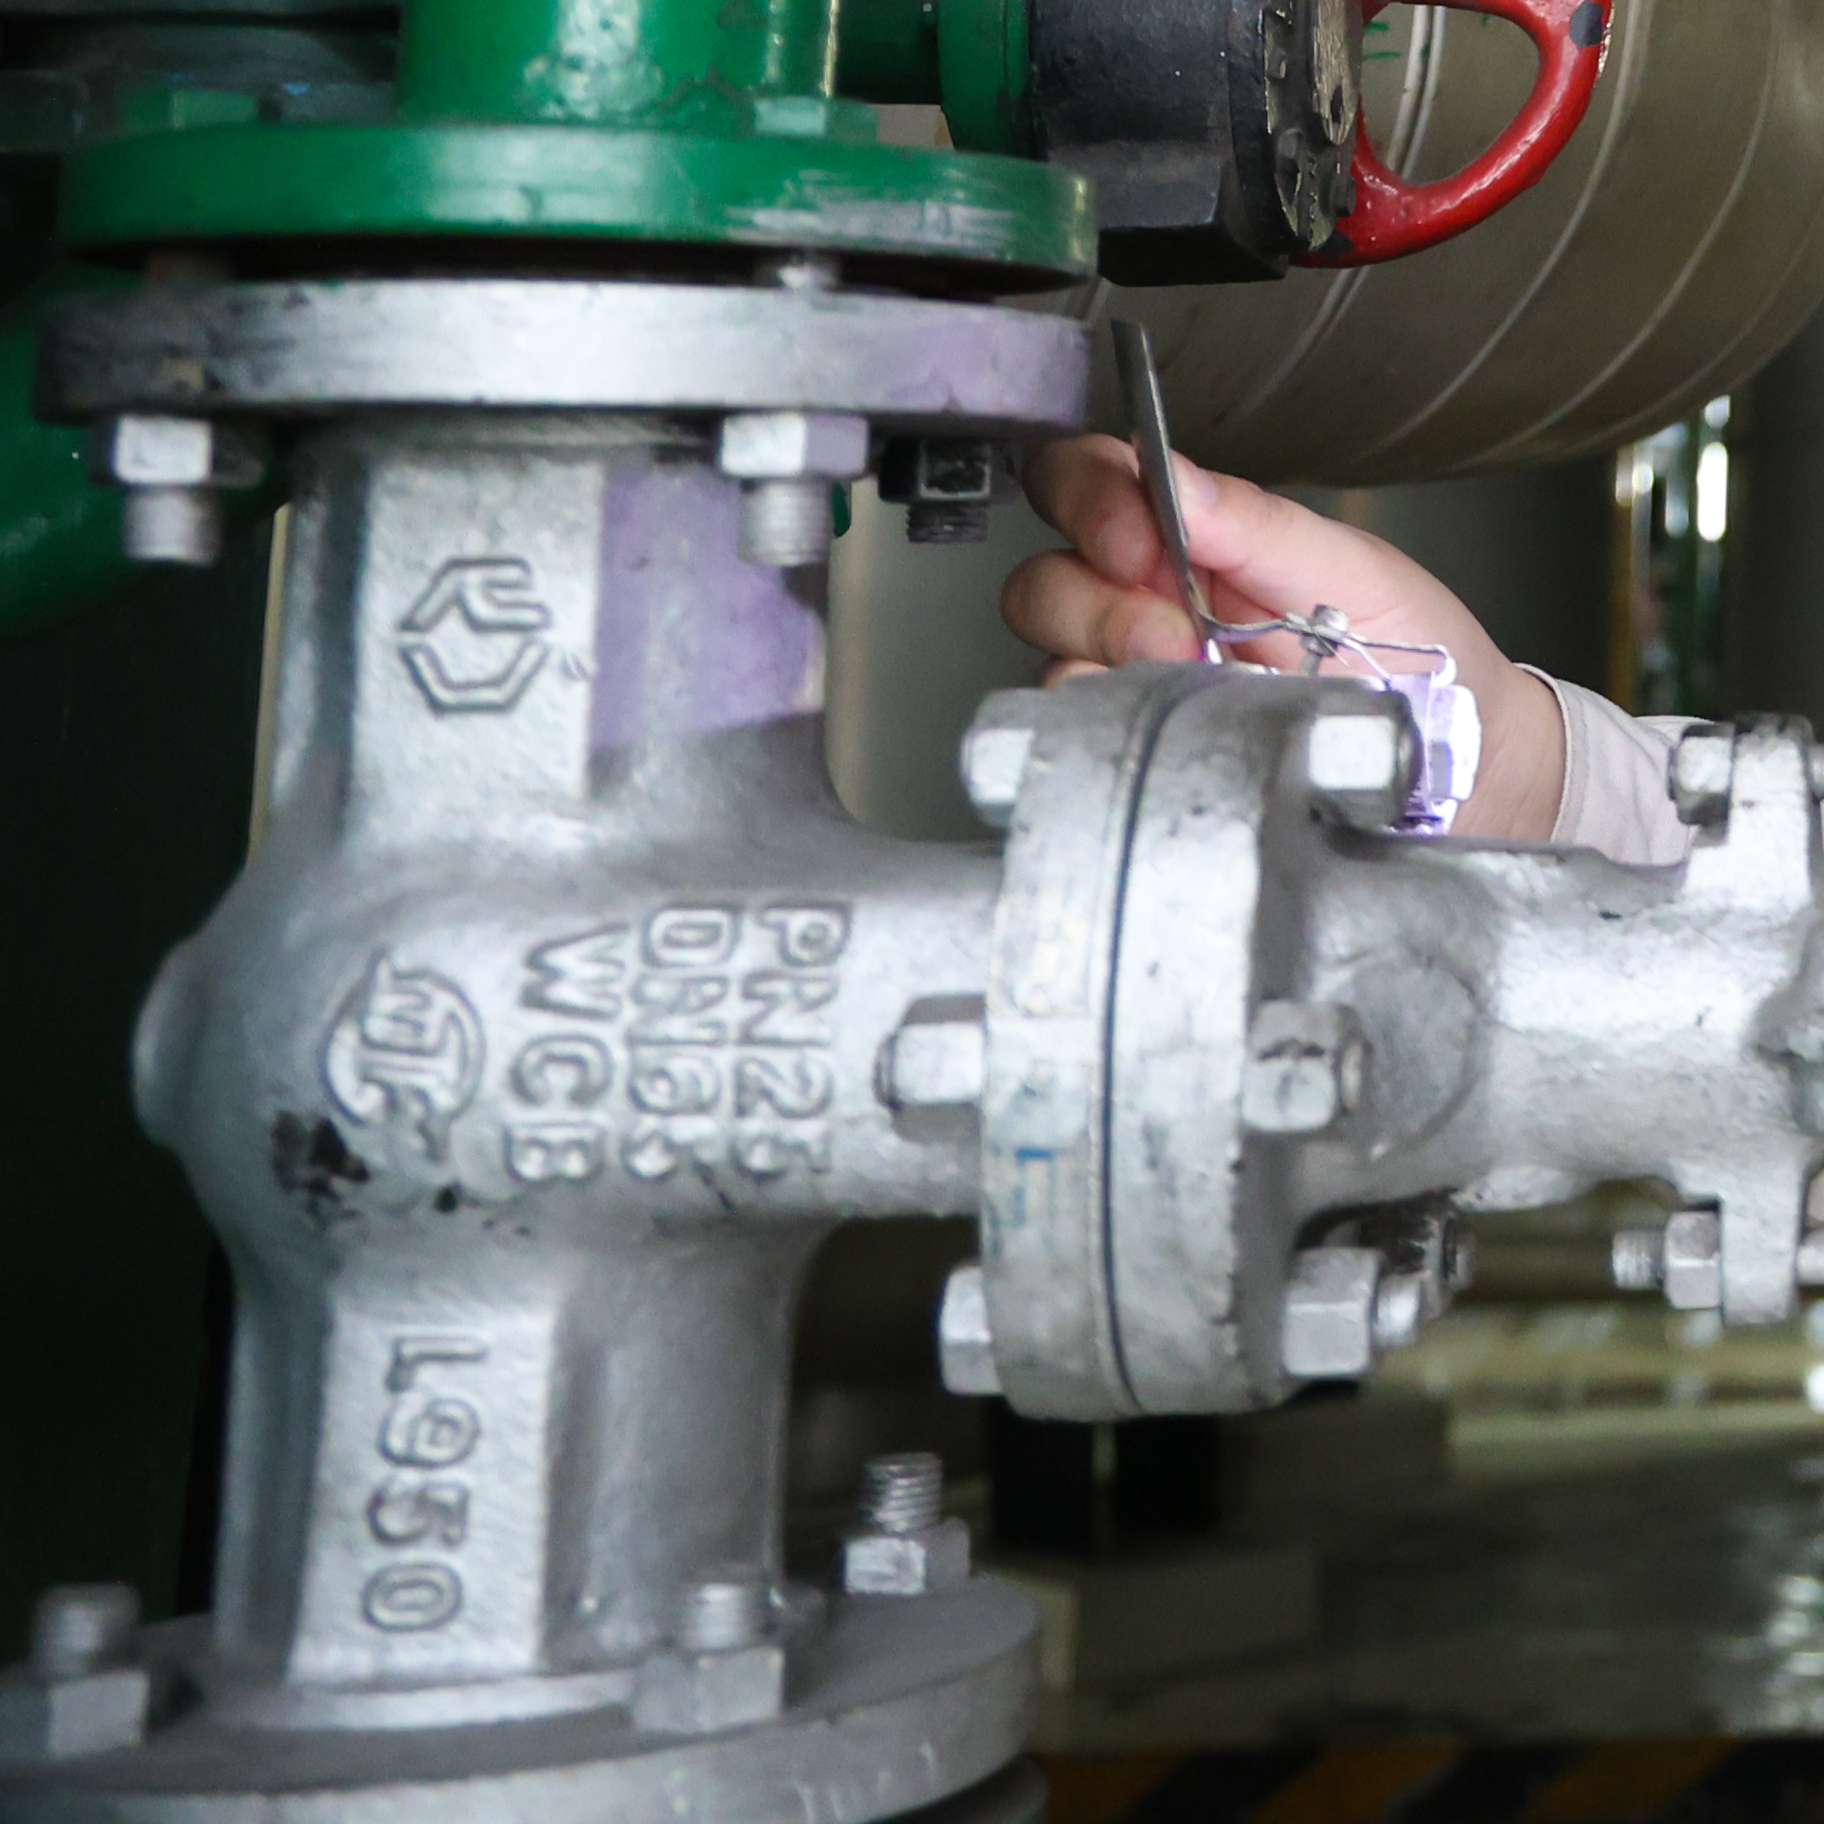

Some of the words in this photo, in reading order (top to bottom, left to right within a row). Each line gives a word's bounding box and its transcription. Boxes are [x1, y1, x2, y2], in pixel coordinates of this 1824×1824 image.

[504, 922, 632, 1180] WCB
[731, 900, 853, 1178] PN25
[359, 1336, 490, 1633] L950
